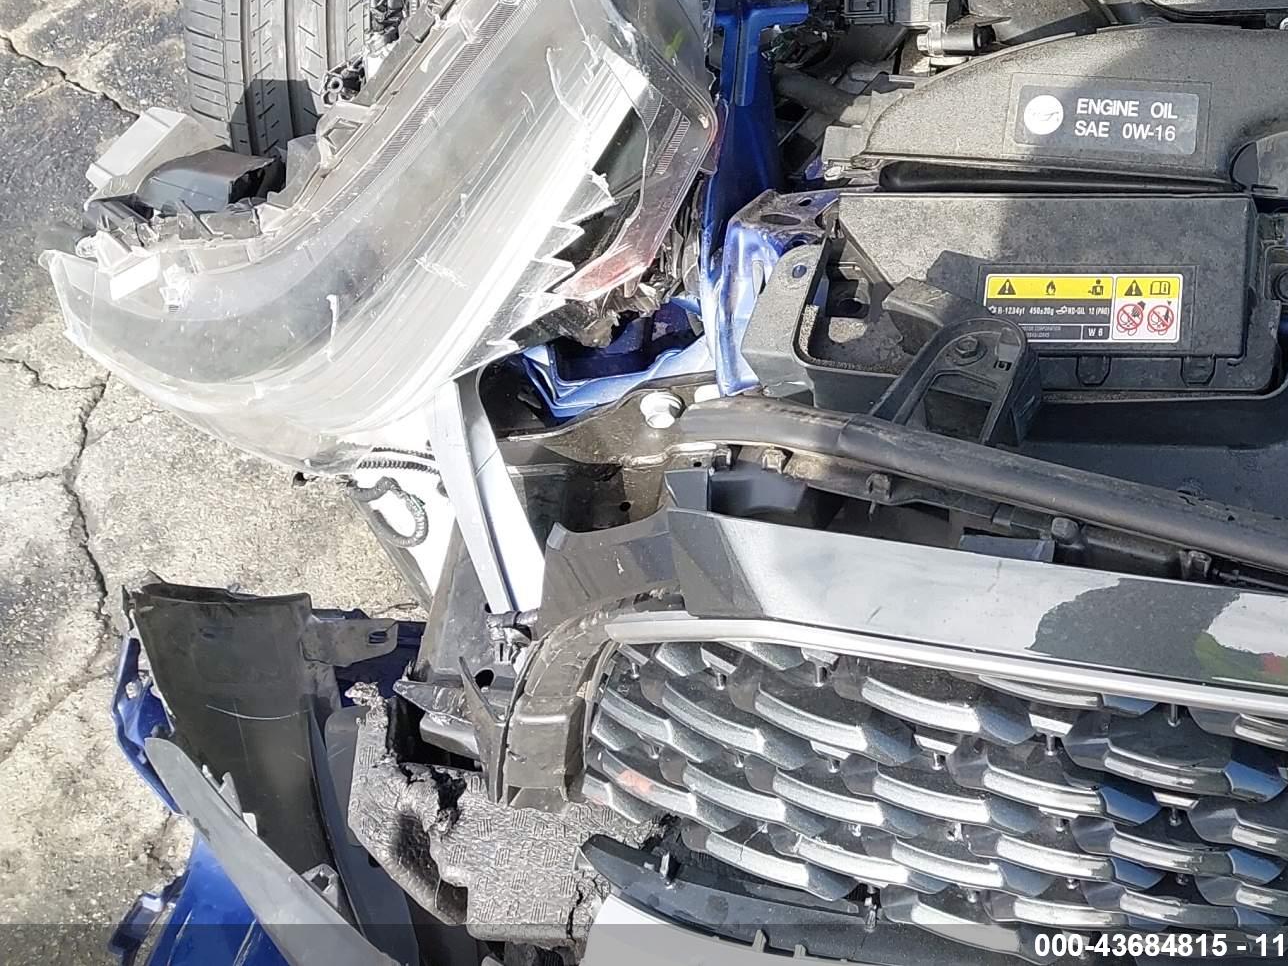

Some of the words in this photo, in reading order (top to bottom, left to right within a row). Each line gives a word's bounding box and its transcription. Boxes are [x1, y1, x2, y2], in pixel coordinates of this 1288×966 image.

[1076, 98, 1140, 117] ENGINE
[1150, 102, 1178, 119] OIL
[1074, 120, 1110, 137] SAE
[1122, 123, 1176, 142] 0W-16
